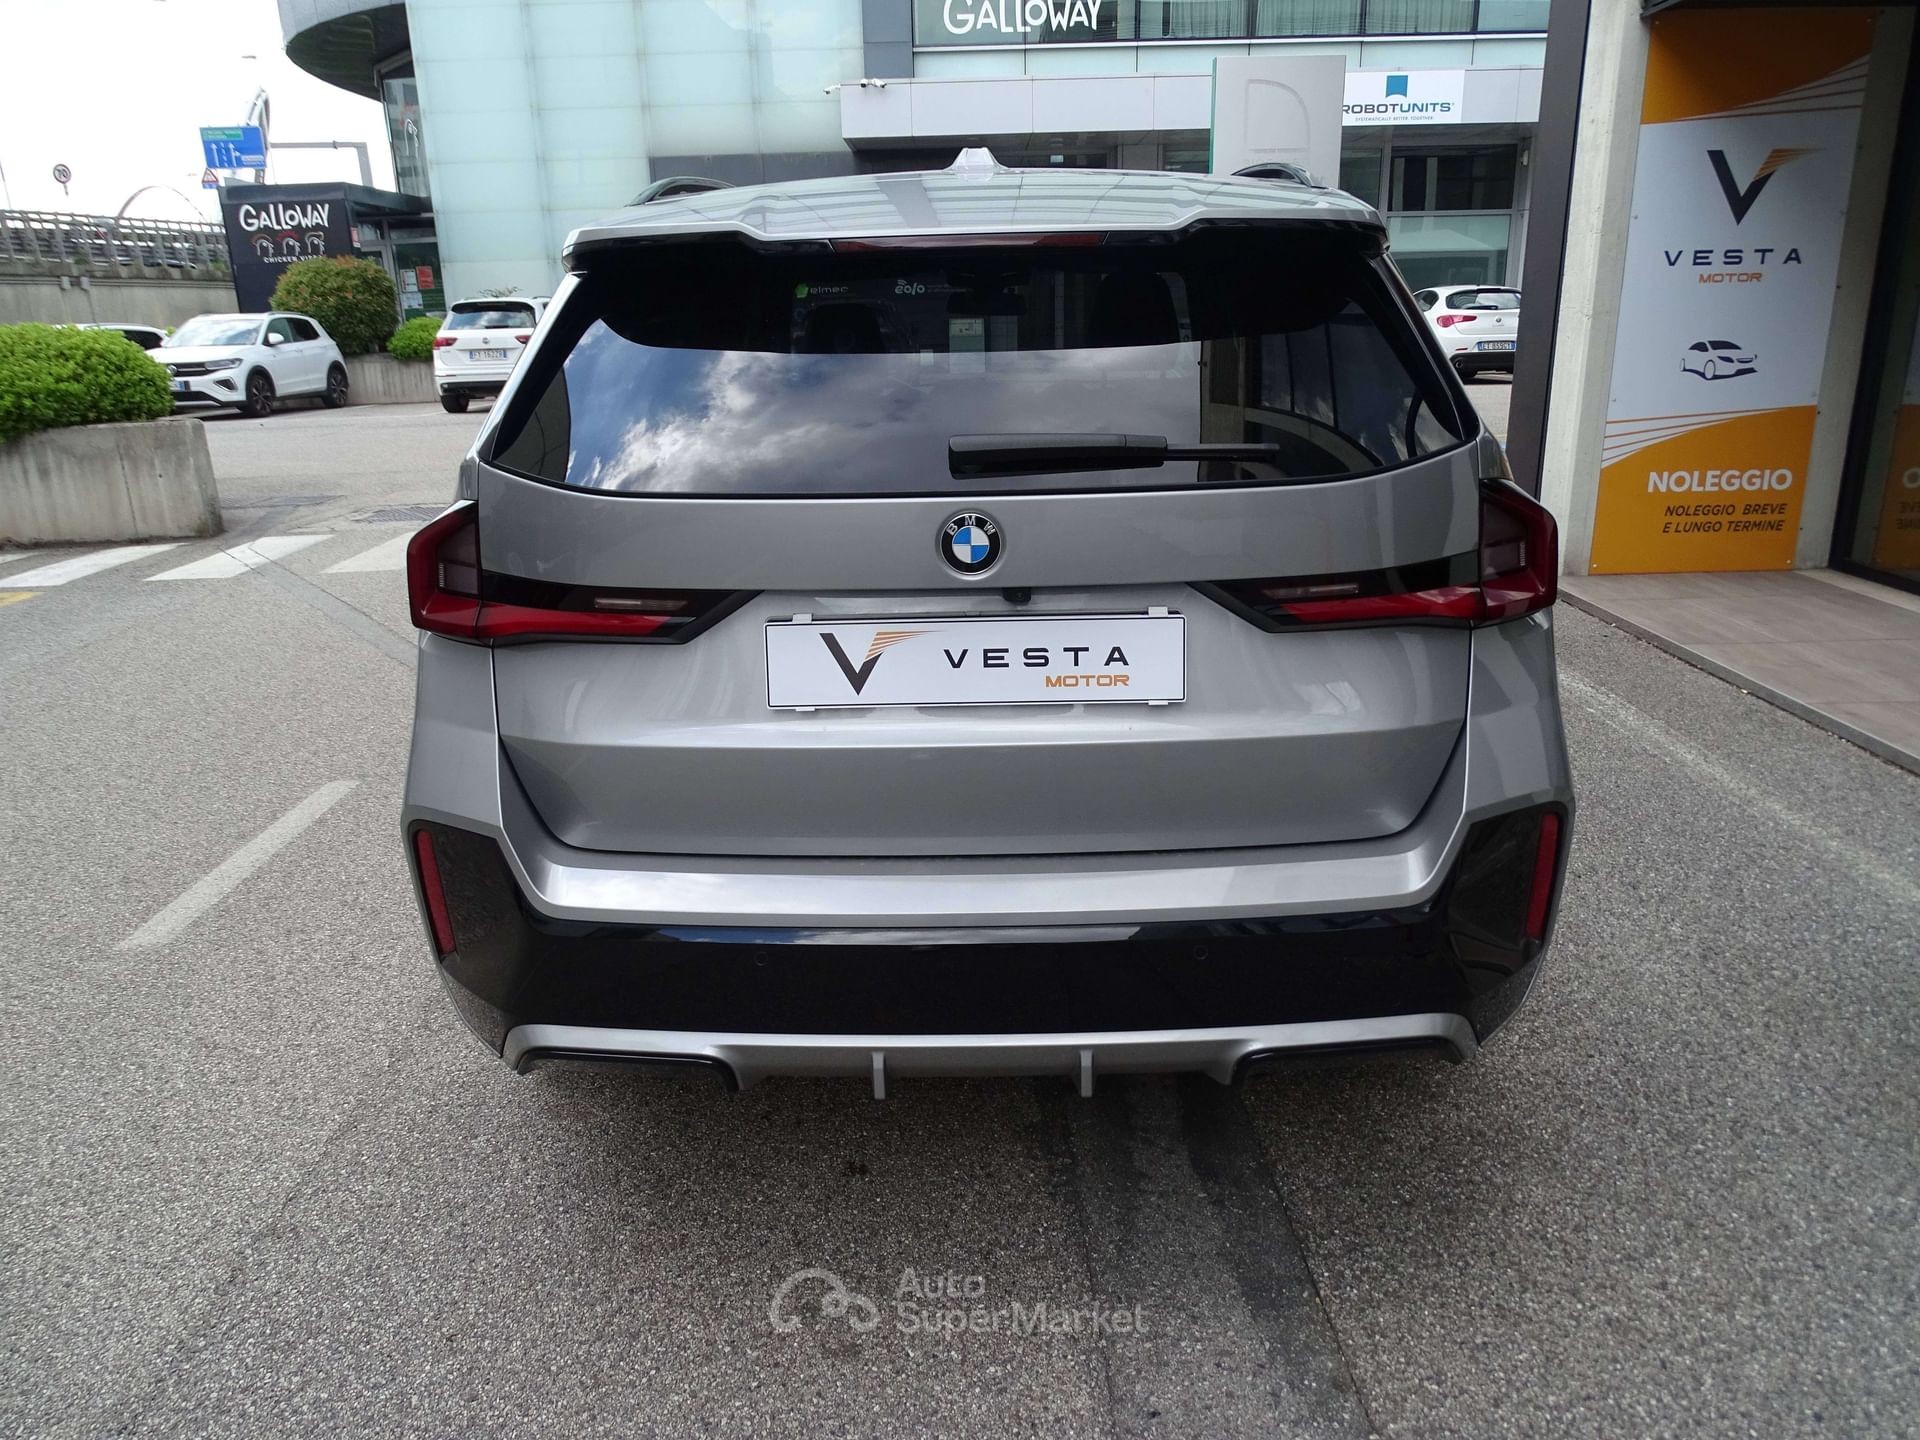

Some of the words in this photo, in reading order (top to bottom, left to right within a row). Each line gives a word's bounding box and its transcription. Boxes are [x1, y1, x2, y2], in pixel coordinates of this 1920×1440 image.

[943, 0, 1101, 35] GALLOWAY
[1342, 102, 1451, 115] ROBOTUNITS
[239, 203, 330, 231] GALLOWAY
[1663, 248, 1802, 267] VESTA
[1698, 272, 1763, 284] MOTOR
[1647, 469, 1793, 493] NOLEGGIO
[1664, 504, 1736, 517] NOLEGGIO
[1742, 503, 1788, 515] BREVE
[947, 514, 996, 536] BMW
[1662, 522, 1672, 533] E
[1674, 521, 1722, 533] LUNGO
[1727, 519, 1785, 532] TERMINE
[942, 646, 1130, 669] VESTA
[1045, 673, 1130, 688] MOTOR
